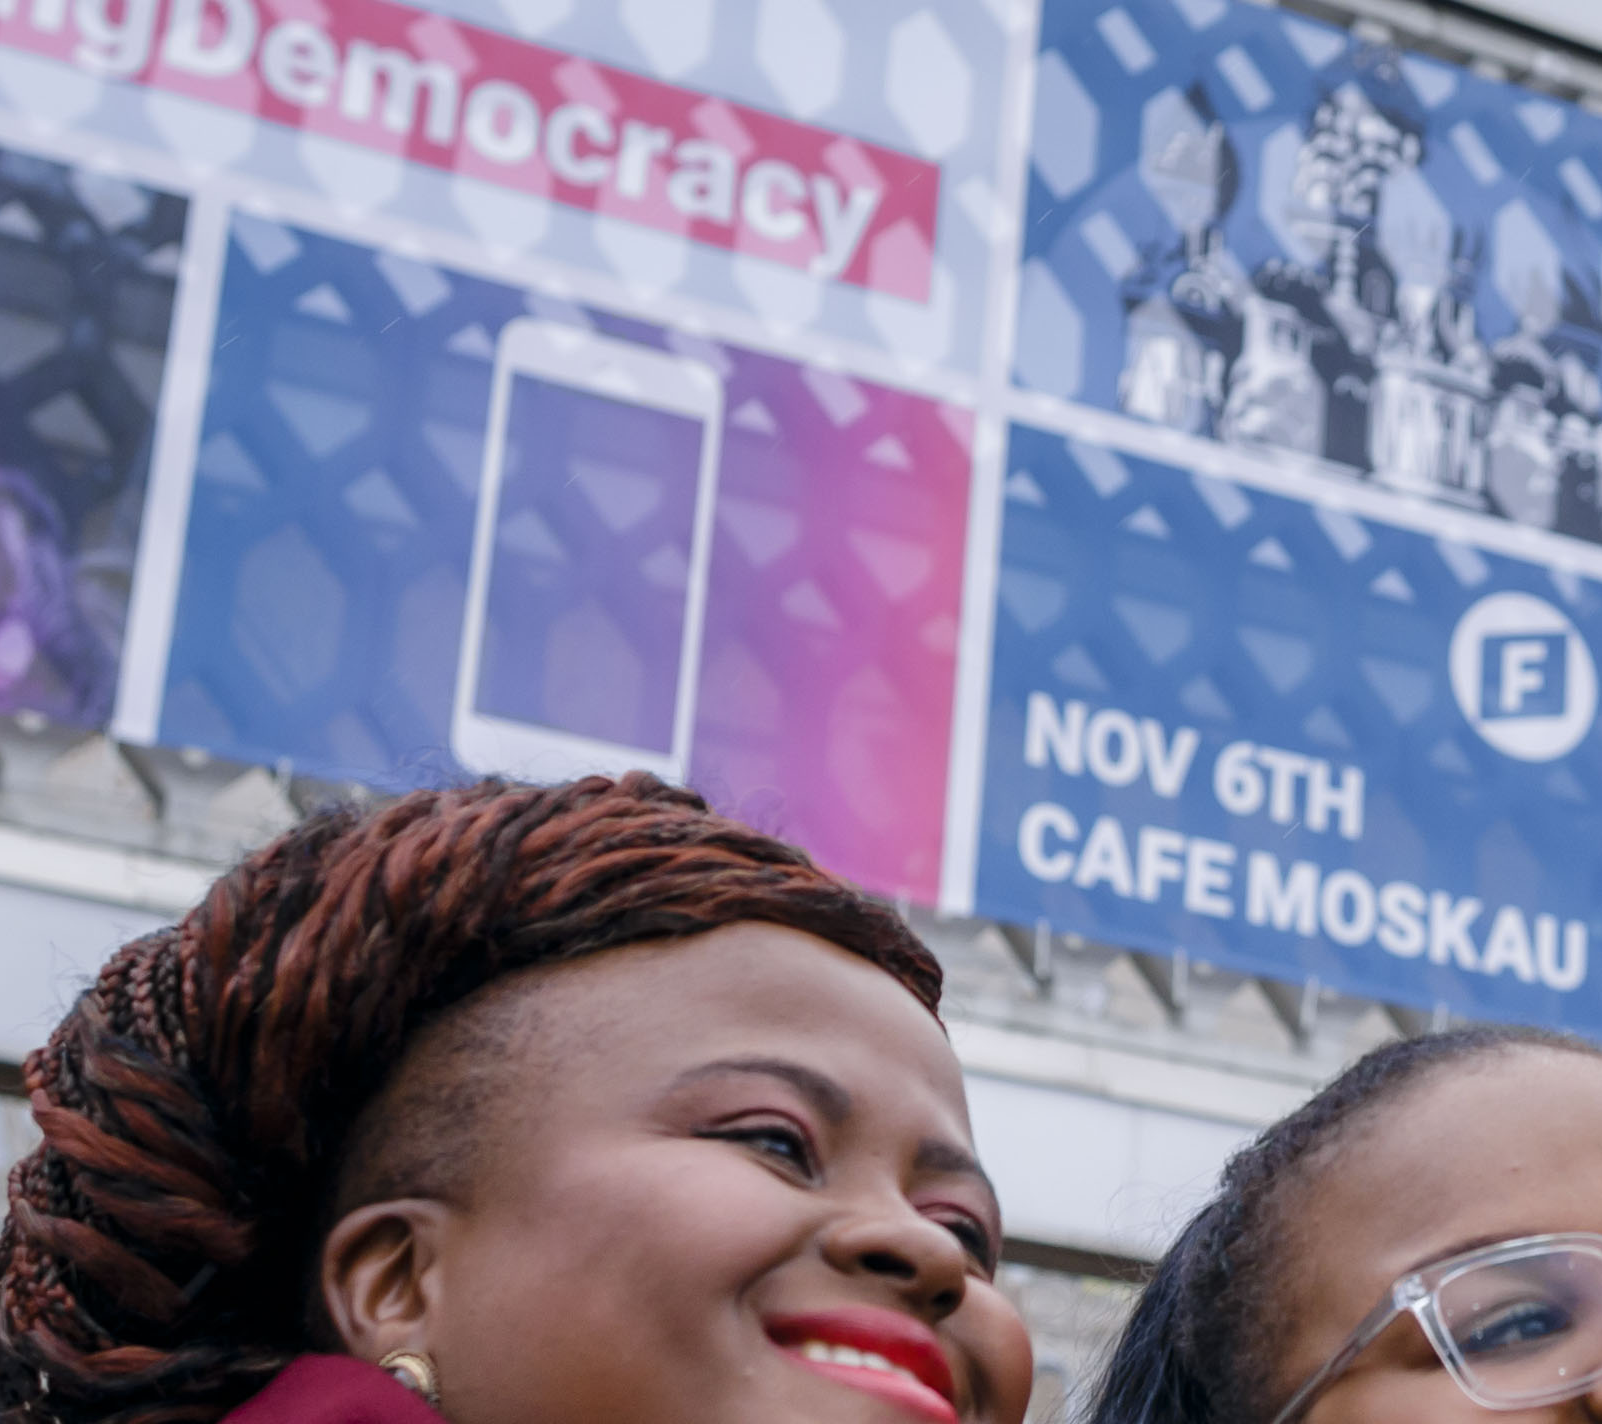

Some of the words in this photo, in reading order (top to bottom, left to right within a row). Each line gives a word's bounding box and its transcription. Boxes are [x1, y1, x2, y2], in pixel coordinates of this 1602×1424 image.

[1499, 639, 1548, 714] F
[1024, 690, 1201, 799] NOV
[1212, 740, 1366, 840] 6TH
[1017, 802, 1238, 919] CAFE
[1245, 851, 1589, 992] MOSKAU
